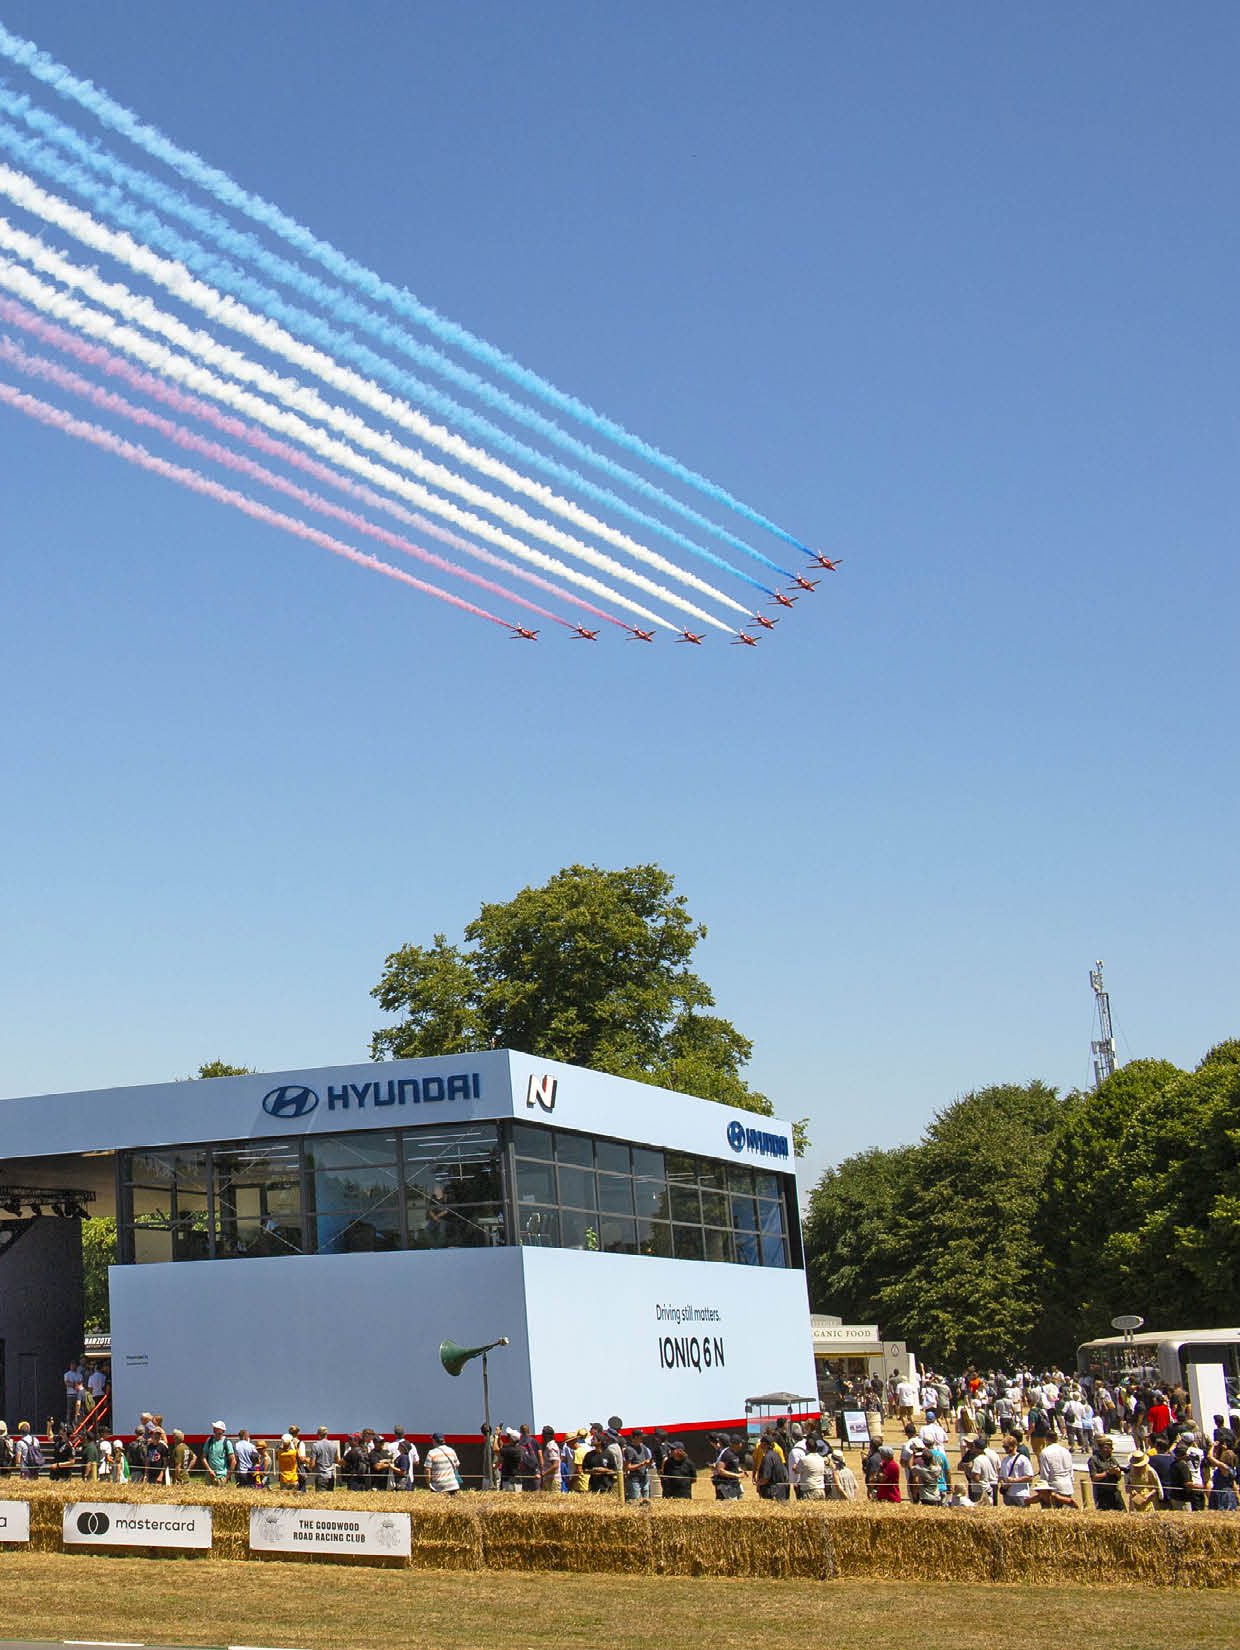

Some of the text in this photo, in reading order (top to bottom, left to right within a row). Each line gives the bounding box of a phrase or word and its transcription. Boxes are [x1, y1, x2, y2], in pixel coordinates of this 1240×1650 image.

[327, 1072, 480, 1111] HYUNDAI
[745, 1128, 789, 1159] HYUNDAI
[656, 1303, 721, 1324] Driving still matters.
[658, 1336, 725, 1374] IONIQ 6 N
[115, 1518, 195, 1533] mastercard
[299, 1520, 360, 1531] THE GOODWOOD
[293, 1532, 366, 1543] ROAD RACING CLUB
